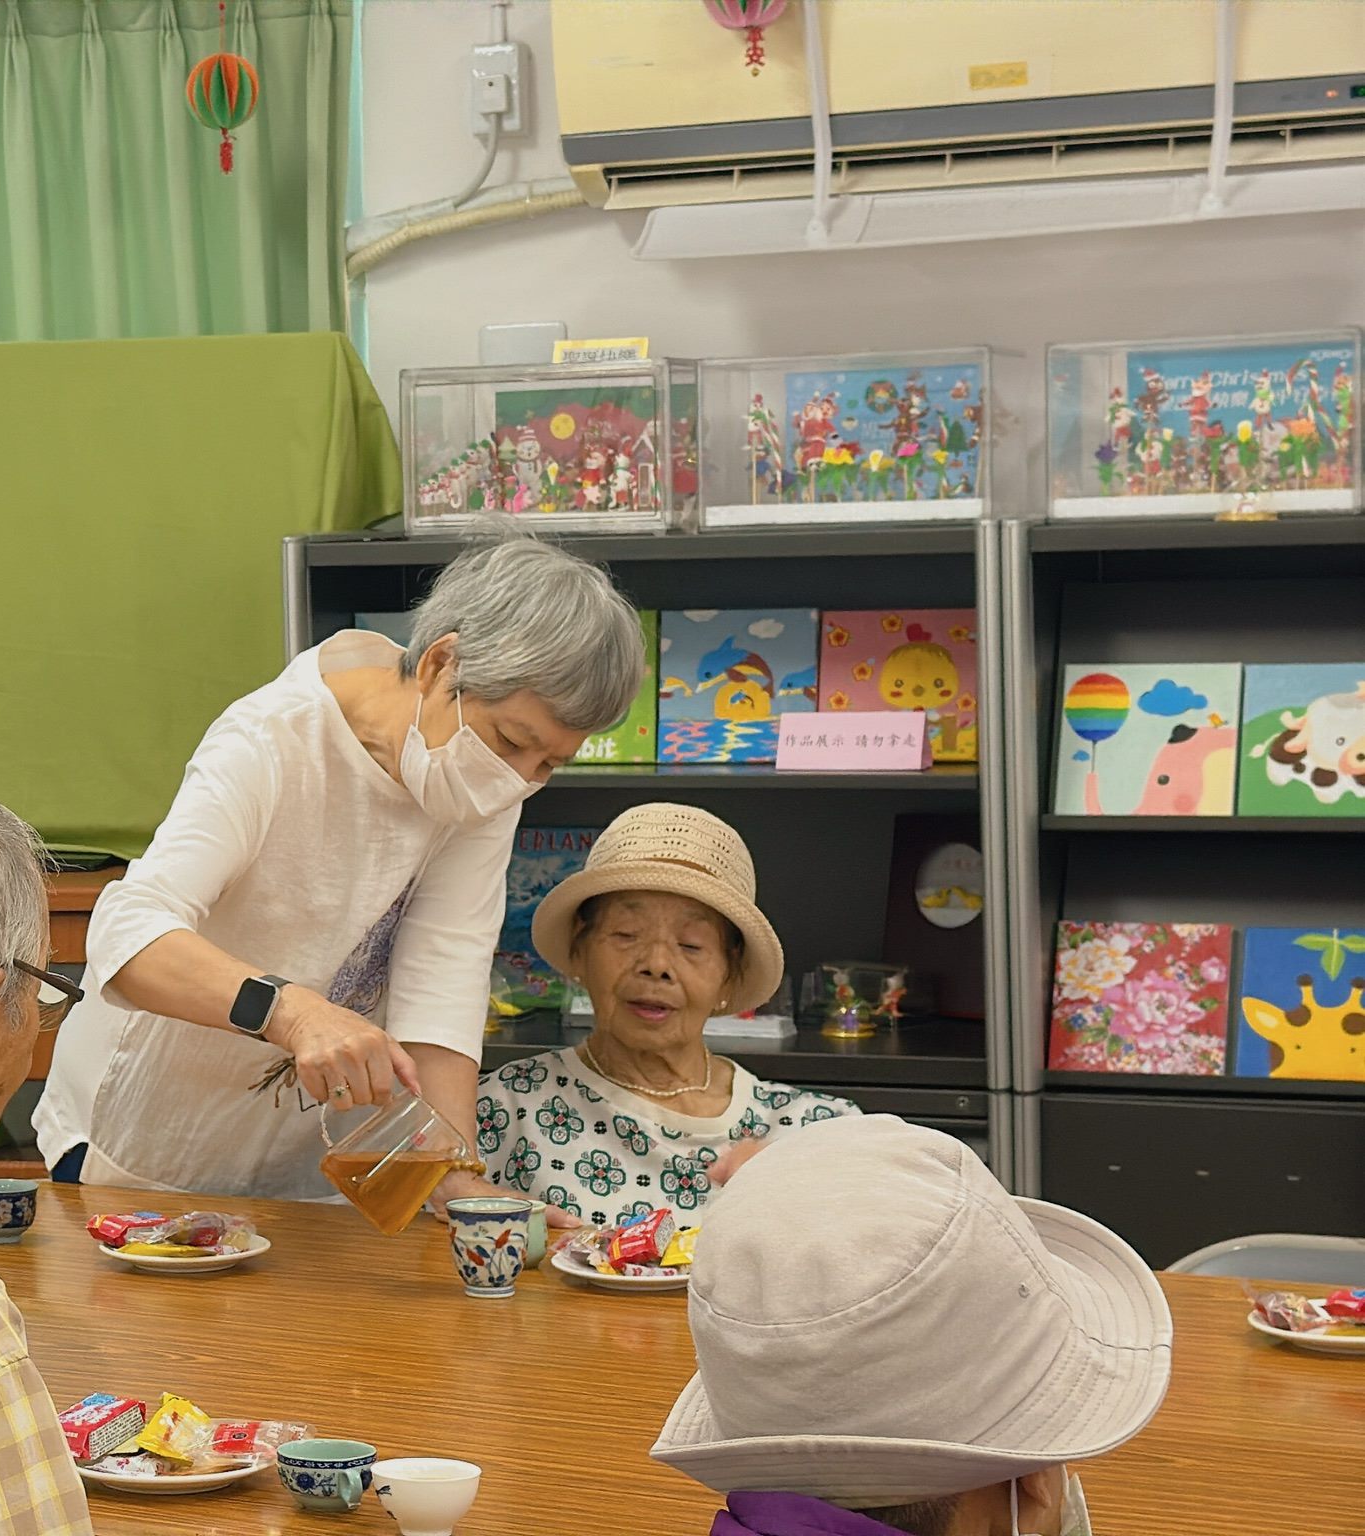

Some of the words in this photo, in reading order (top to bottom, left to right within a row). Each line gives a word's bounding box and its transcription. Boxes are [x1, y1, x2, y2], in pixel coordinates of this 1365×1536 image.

[575, 737, 616, 759] bit
[785, 734, 844, 748] 作品展示
[854, 733, 917, 748] 請勿拿走
